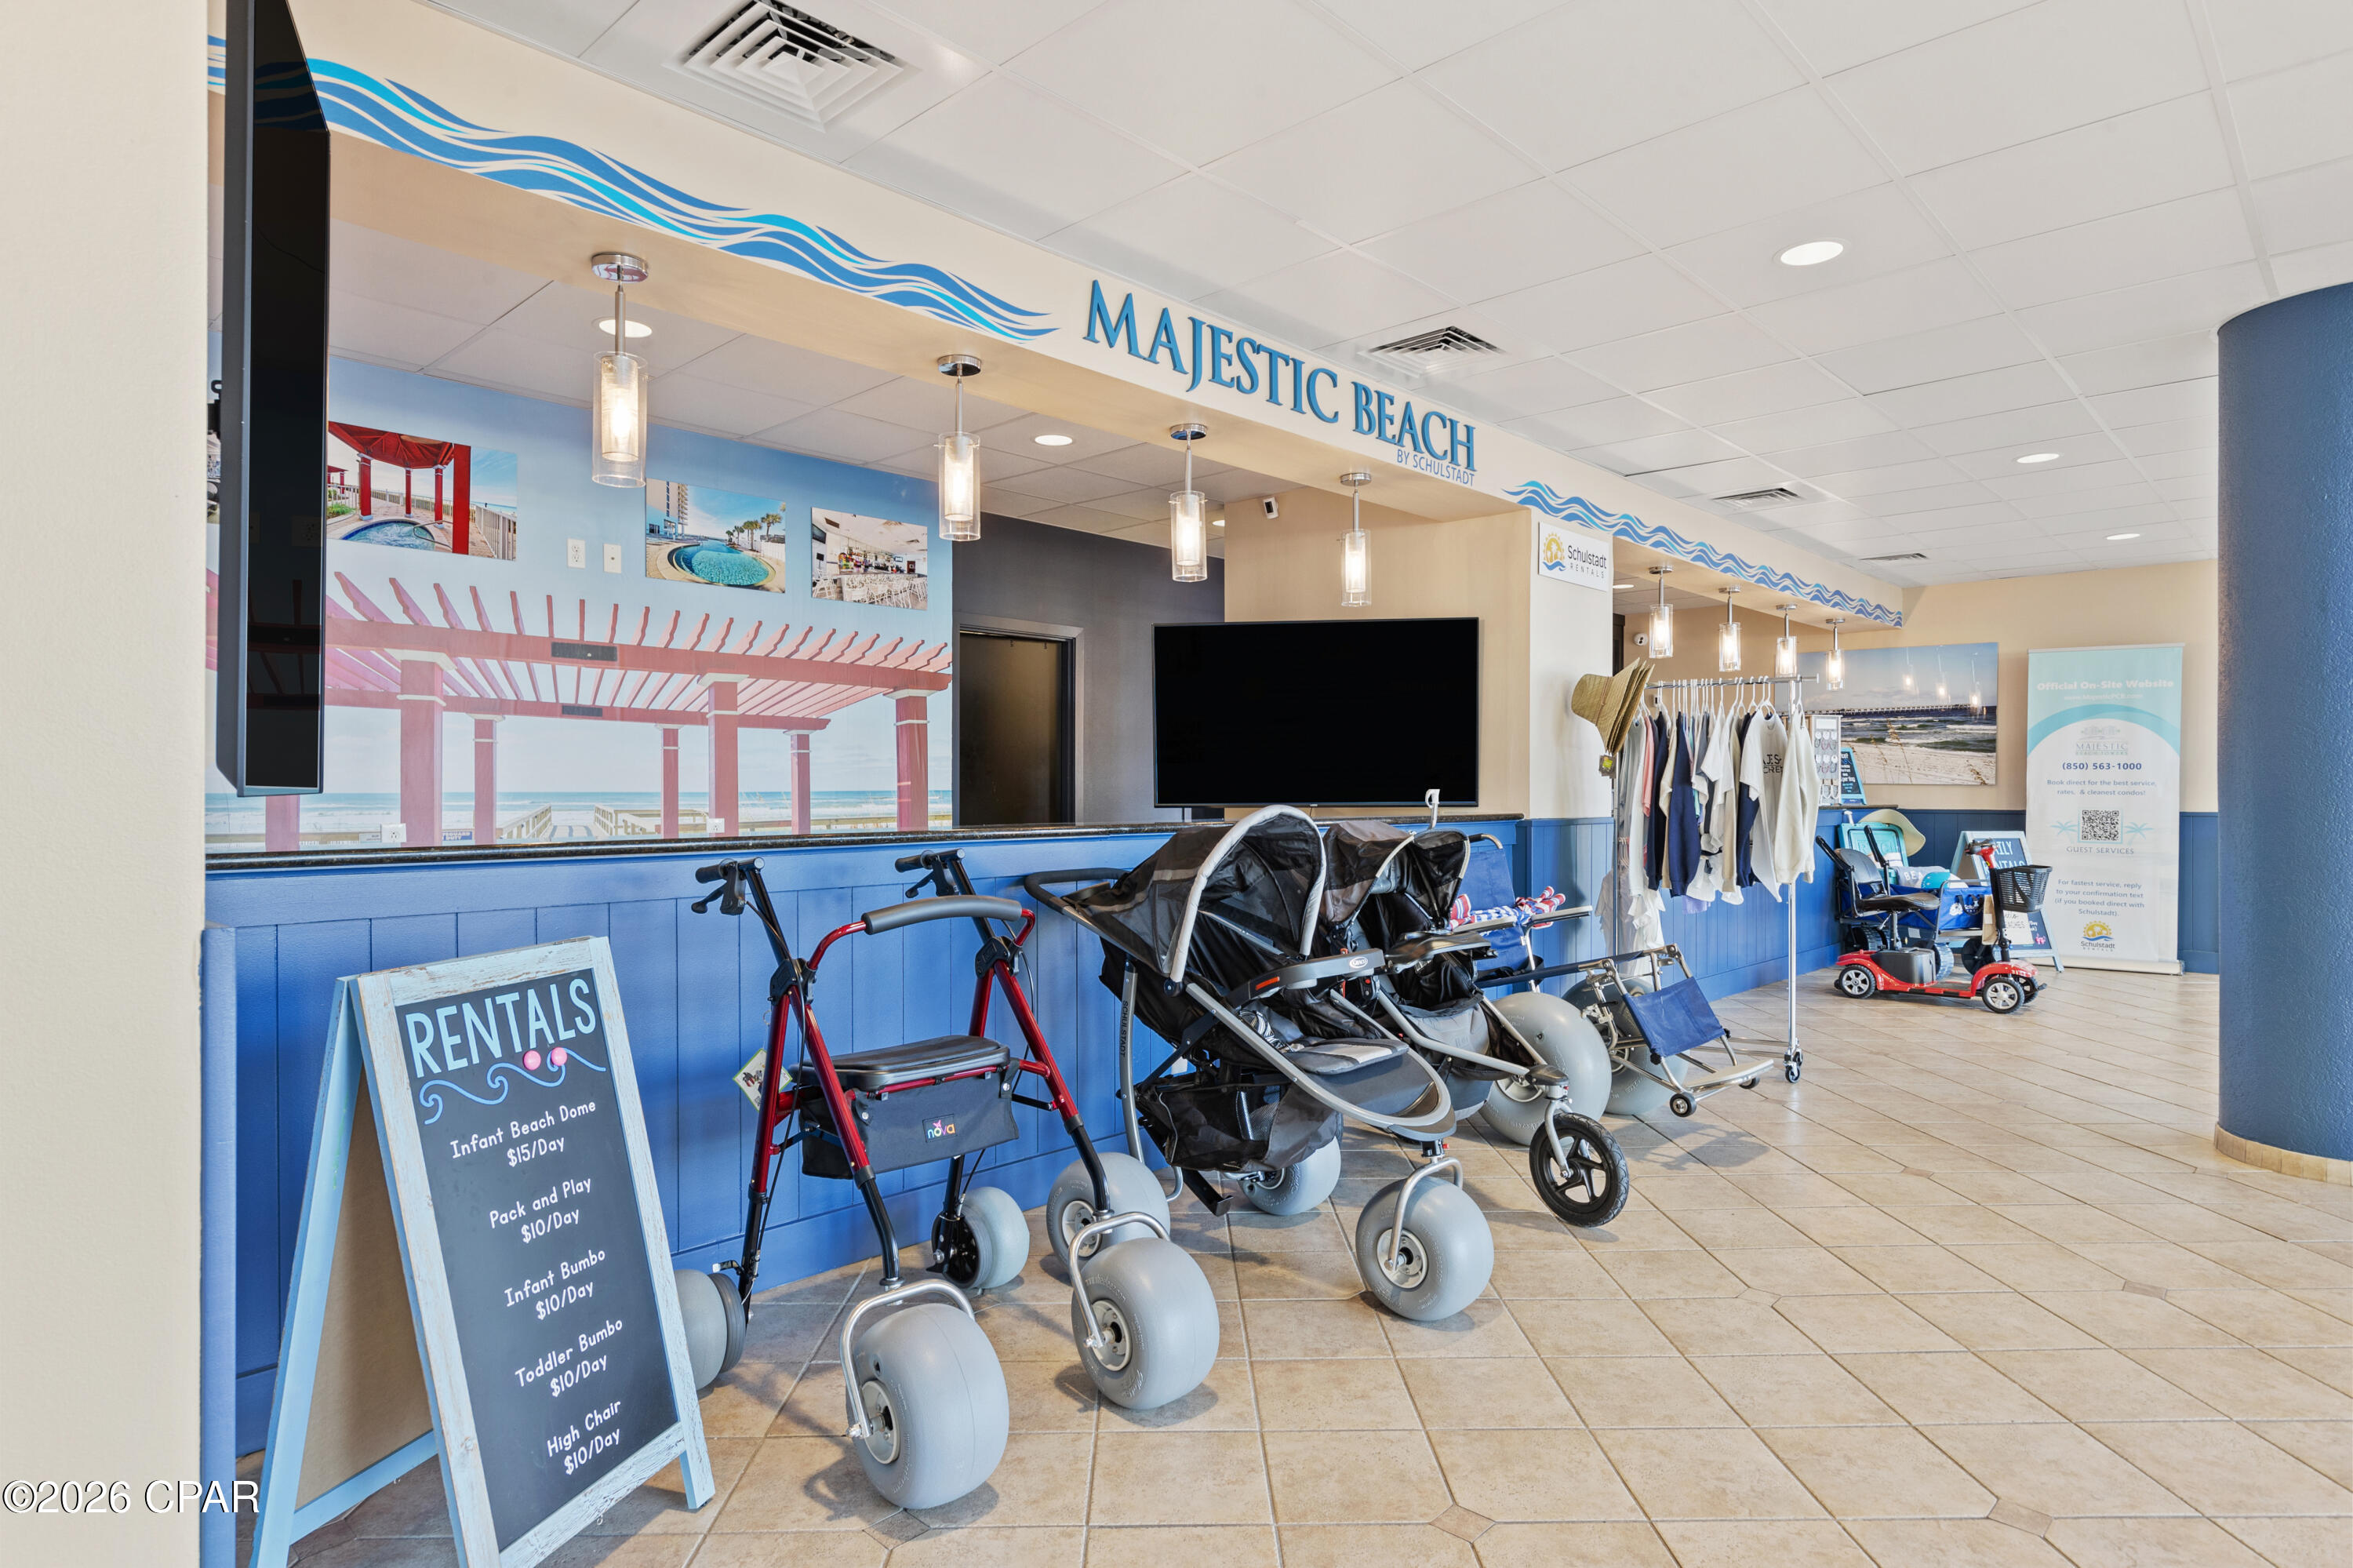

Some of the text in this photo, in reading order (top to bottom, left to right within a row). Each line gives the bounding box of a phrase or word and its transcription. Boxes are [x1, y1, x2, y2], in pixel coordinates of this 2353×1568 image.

[1083, 278, 1478, 473] MAJESTIC BEACH
[1396, 448, 1476, 488] BY SCHULSTADT
[1567, 544, 1607, 569] Schulstadt
[1569, 562, 1605, 580] RENTALS
[2037, 678, 2174, 691] Official On-Site Website
[2062, 762, 2089, 770] (850)
[2075, 742, 2129, 751] MAJESTIC
[2080, 940, 2115, 949] Schulstadt
[405, 977, 597, 1079] RENTALS
[1120, 1000, 1129, 1058] SCHULSTADT
[449, 1101, 596, 1159] Infant Beach Dome
[927, 1122, 956, 1139] nova
[506, 1137, 565, 1168] $15/Day
[489, 1178, 591, 1229] Pack and Play
[520, 1209, 580, 1244] $10/Day
[504, 1249, 606, 1308] Infant Bumbo
[535, 1282, 594, 1321] $10/Day
[514, 1319, 623, 1388] Toddler Bumbo
[550, 1355, 607, 1398] $10/Day
[546, 1400, 621, 1458] High Chair
[563, 1428, 620, 1475] $10/Day
